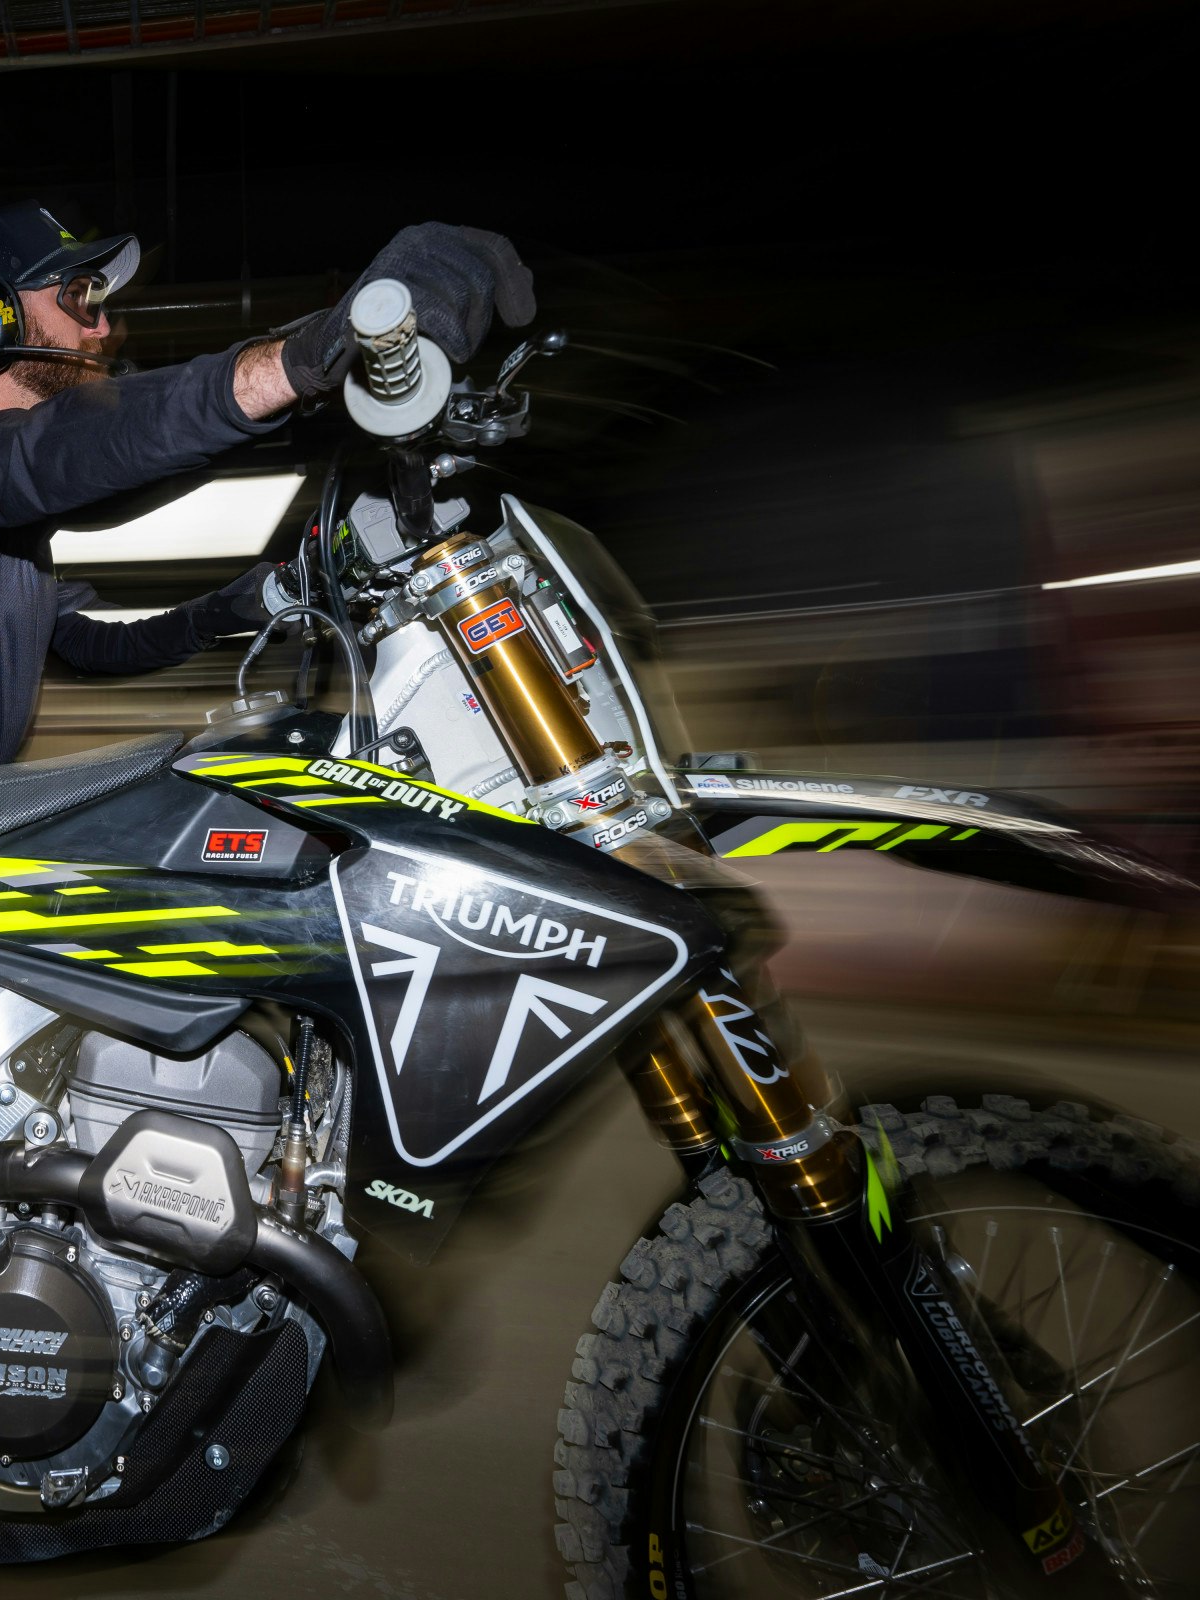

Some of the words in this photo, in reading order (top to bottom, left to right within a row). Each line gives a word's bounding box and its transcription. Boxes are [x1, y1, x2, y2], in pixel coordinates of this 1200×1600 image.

[437, 546, 482, 576] XTRIG
[455, 566, 498, 597] ROCS
[467, 606, 518, 643] GET
[462, 691, 481, 715] AMA
[307, 759, 368, 791] CALL
[367, 776, 389, 789] OF
[381, 782, 464, 820] DUTY
[568, 777, 626, 814] XTRIG
[697, 782, 730, 790] FUCHS
[736, 778, 854, 795] Silkolene
[893, 785, 991, 808] FXR
[209, 832, 264, 852] ETS
[593, 810, 648, 848] ROCS
[205, 852, 235, 860] RACING
[387, 871, 607, 968] TRIUMPH
[757, 1139, 809, 1161] XTRIG
[364, 1178, 434, 1219] SKDA
[922, 1301, 1008, 1431] LUBRICANTS
[934, 1300, 1046, 1477] PERFORMANCE
